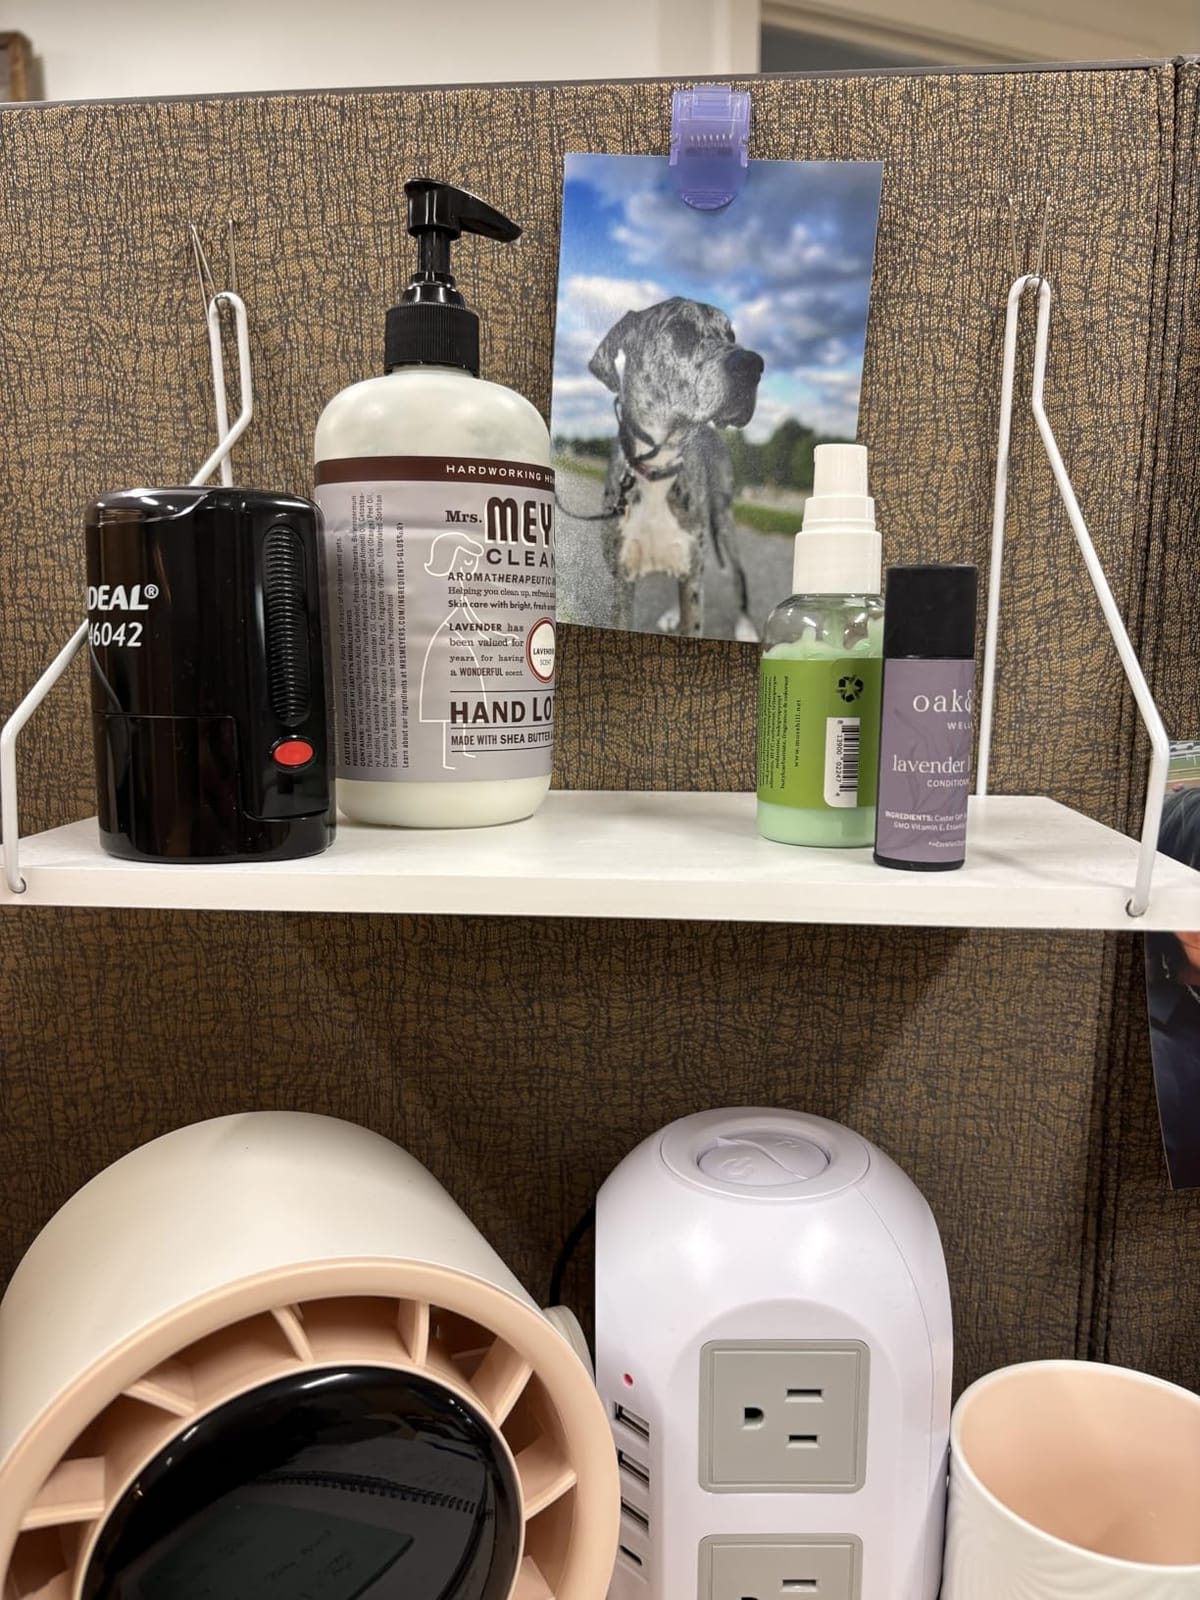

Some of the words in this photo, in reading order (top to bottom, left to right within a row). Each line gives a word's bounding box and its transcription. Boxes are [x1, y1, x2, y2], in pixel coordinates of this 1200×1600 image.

[446, 464, 541, 481] HARDWORKING
[445, 510, 482, 523] Mrs.
[448, 572, 551, 585] AROMATHERAPEUTIC
[448, 587, 482, 596] Helping
[500, 588, 519, 596] clean
[448, 600, 468, 608] Skin
[490, 600, 508, 609] with
[510, 601, 532, 611] bright,
[449, 623, 502, 632] LAVENDER
[507, 624, 524, 632] has
[450, 638, 474, 646] been
[478, 638, 508, 646] valued
[511, 639, 524, 647] for
[498, 655, 524, 664] having
[459, 667, 504, 676] WONDERFUL
[400, 680, 409, 716] ingredients
[450, 701, 526, 724] HAND
[451, 735, 475, 746] MADE
[476, 734, 498, 745] WITH
[500, 733, 526, 745] SHEA
[527, 731, 550, 744] BUTTER
[892, 754, 964, 774] lavender
